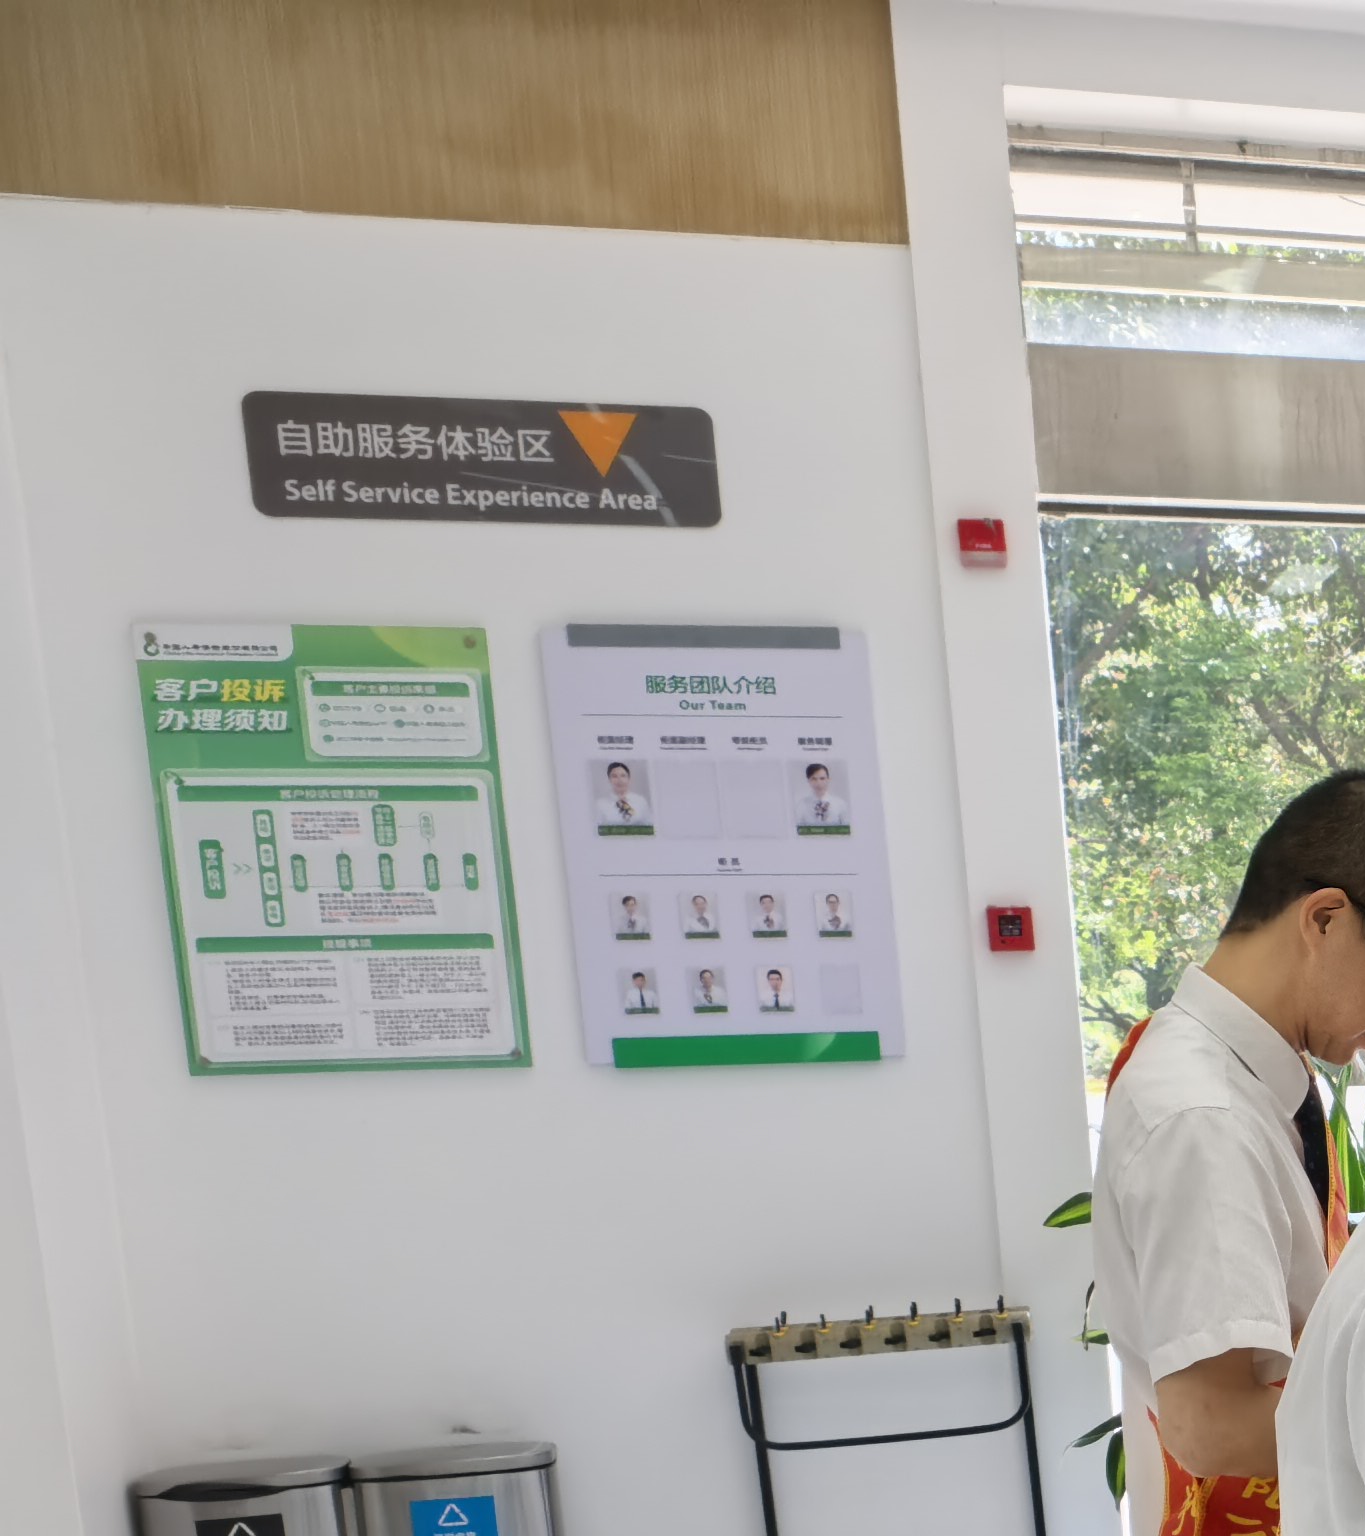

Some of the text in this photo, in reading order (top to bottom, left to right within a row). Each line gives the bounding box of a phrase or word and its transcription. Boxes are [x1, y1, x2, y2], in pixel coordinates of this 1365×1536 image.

[277, 419, 555, 464] 自助服务体验区
[284, 478, 659, 512] Self Service Experience Area
[154, 678, 287, 703] 客户投诉
[645, 675, 776, 695] 服务团队介绍
[678, 699, 747, 711] Our Team
[156, 708, 288, 732] 办理须知
